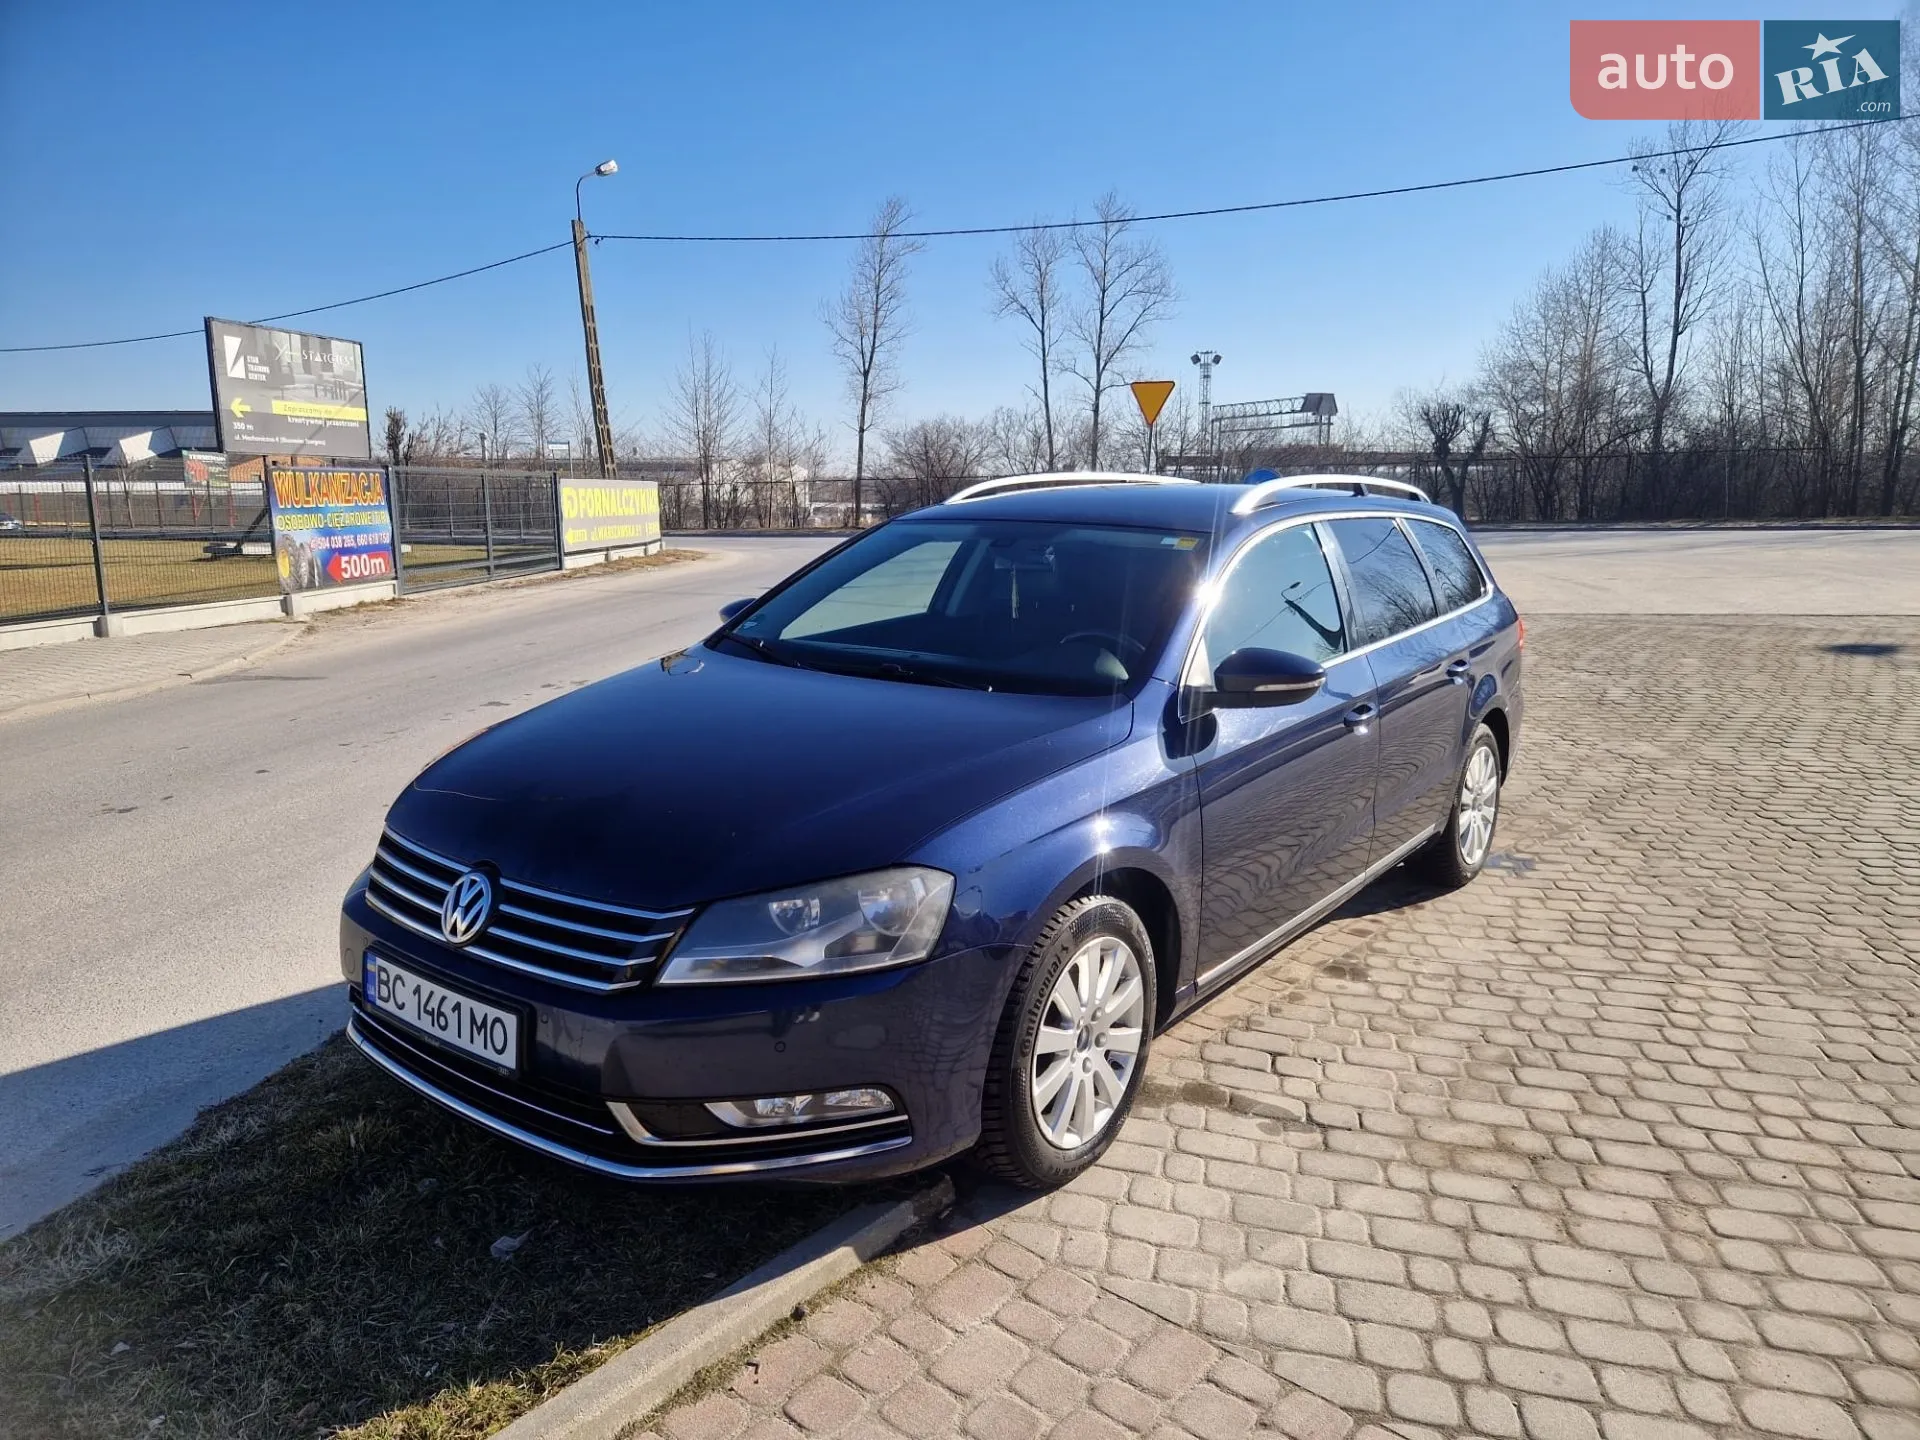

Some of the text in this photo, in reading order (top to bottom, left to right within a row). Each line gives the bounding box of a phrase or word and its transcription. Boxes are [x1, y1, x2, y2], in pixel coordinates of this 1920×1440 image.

[272, 471, 385, 508] WULKANIZACJA
[341, 554, 386, 579] 500m
[377, 964, 509, 1056] BC 1461 MO
